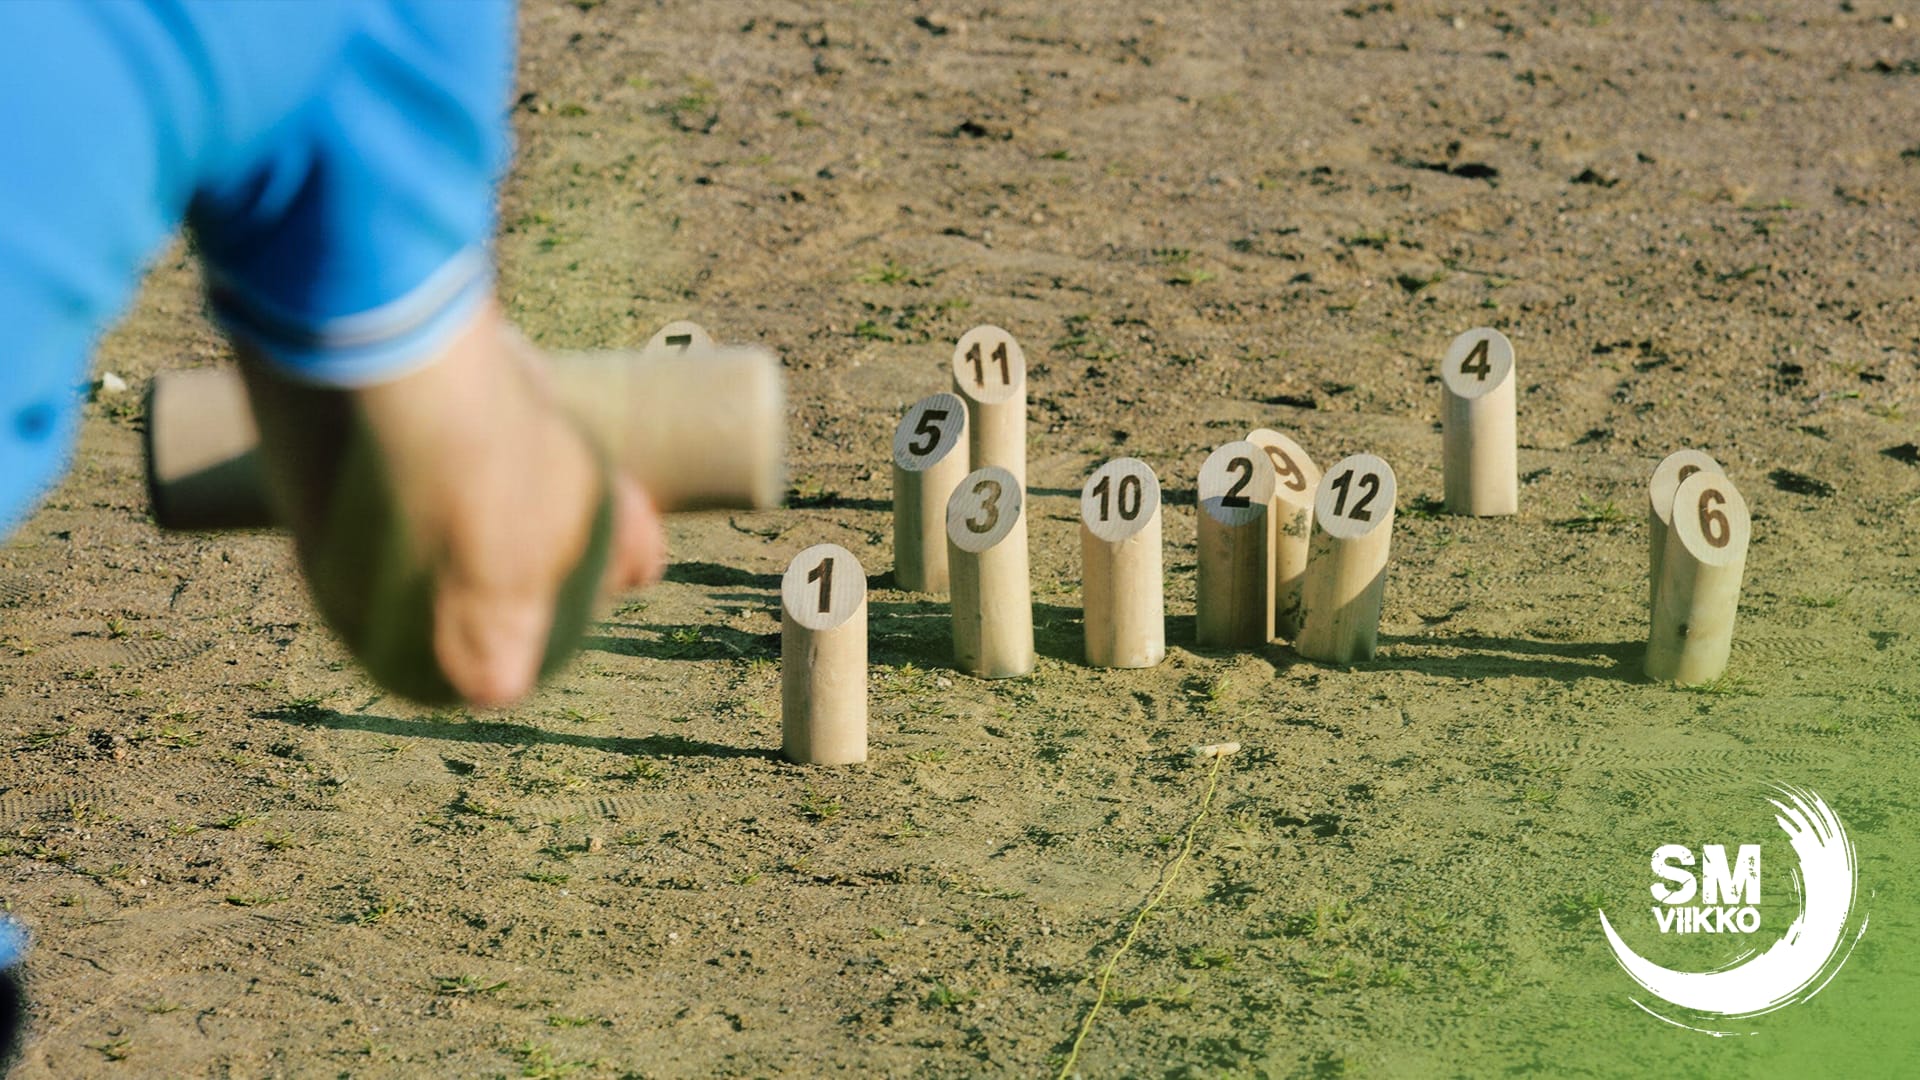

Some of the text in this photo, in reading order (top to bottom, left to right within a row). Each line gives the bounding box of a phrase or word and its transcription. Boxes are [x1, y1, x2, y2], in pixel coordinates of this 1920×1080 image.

[964, 341, 1010, 389] 11
[1460, 339, 1491, 381] 4
[908, 410, 948, 456] 5
[1221, 457, 1254, 508] 2
[1263, 445, 1307, 492] 9
[966, 480, 1001, 533] 3
[1092, 474, 1142, 522] 10
[1330, 469, 1380, 522] 12
[1698, 489, 1730, 548] 6
[807, 557, 834, 613] 1
